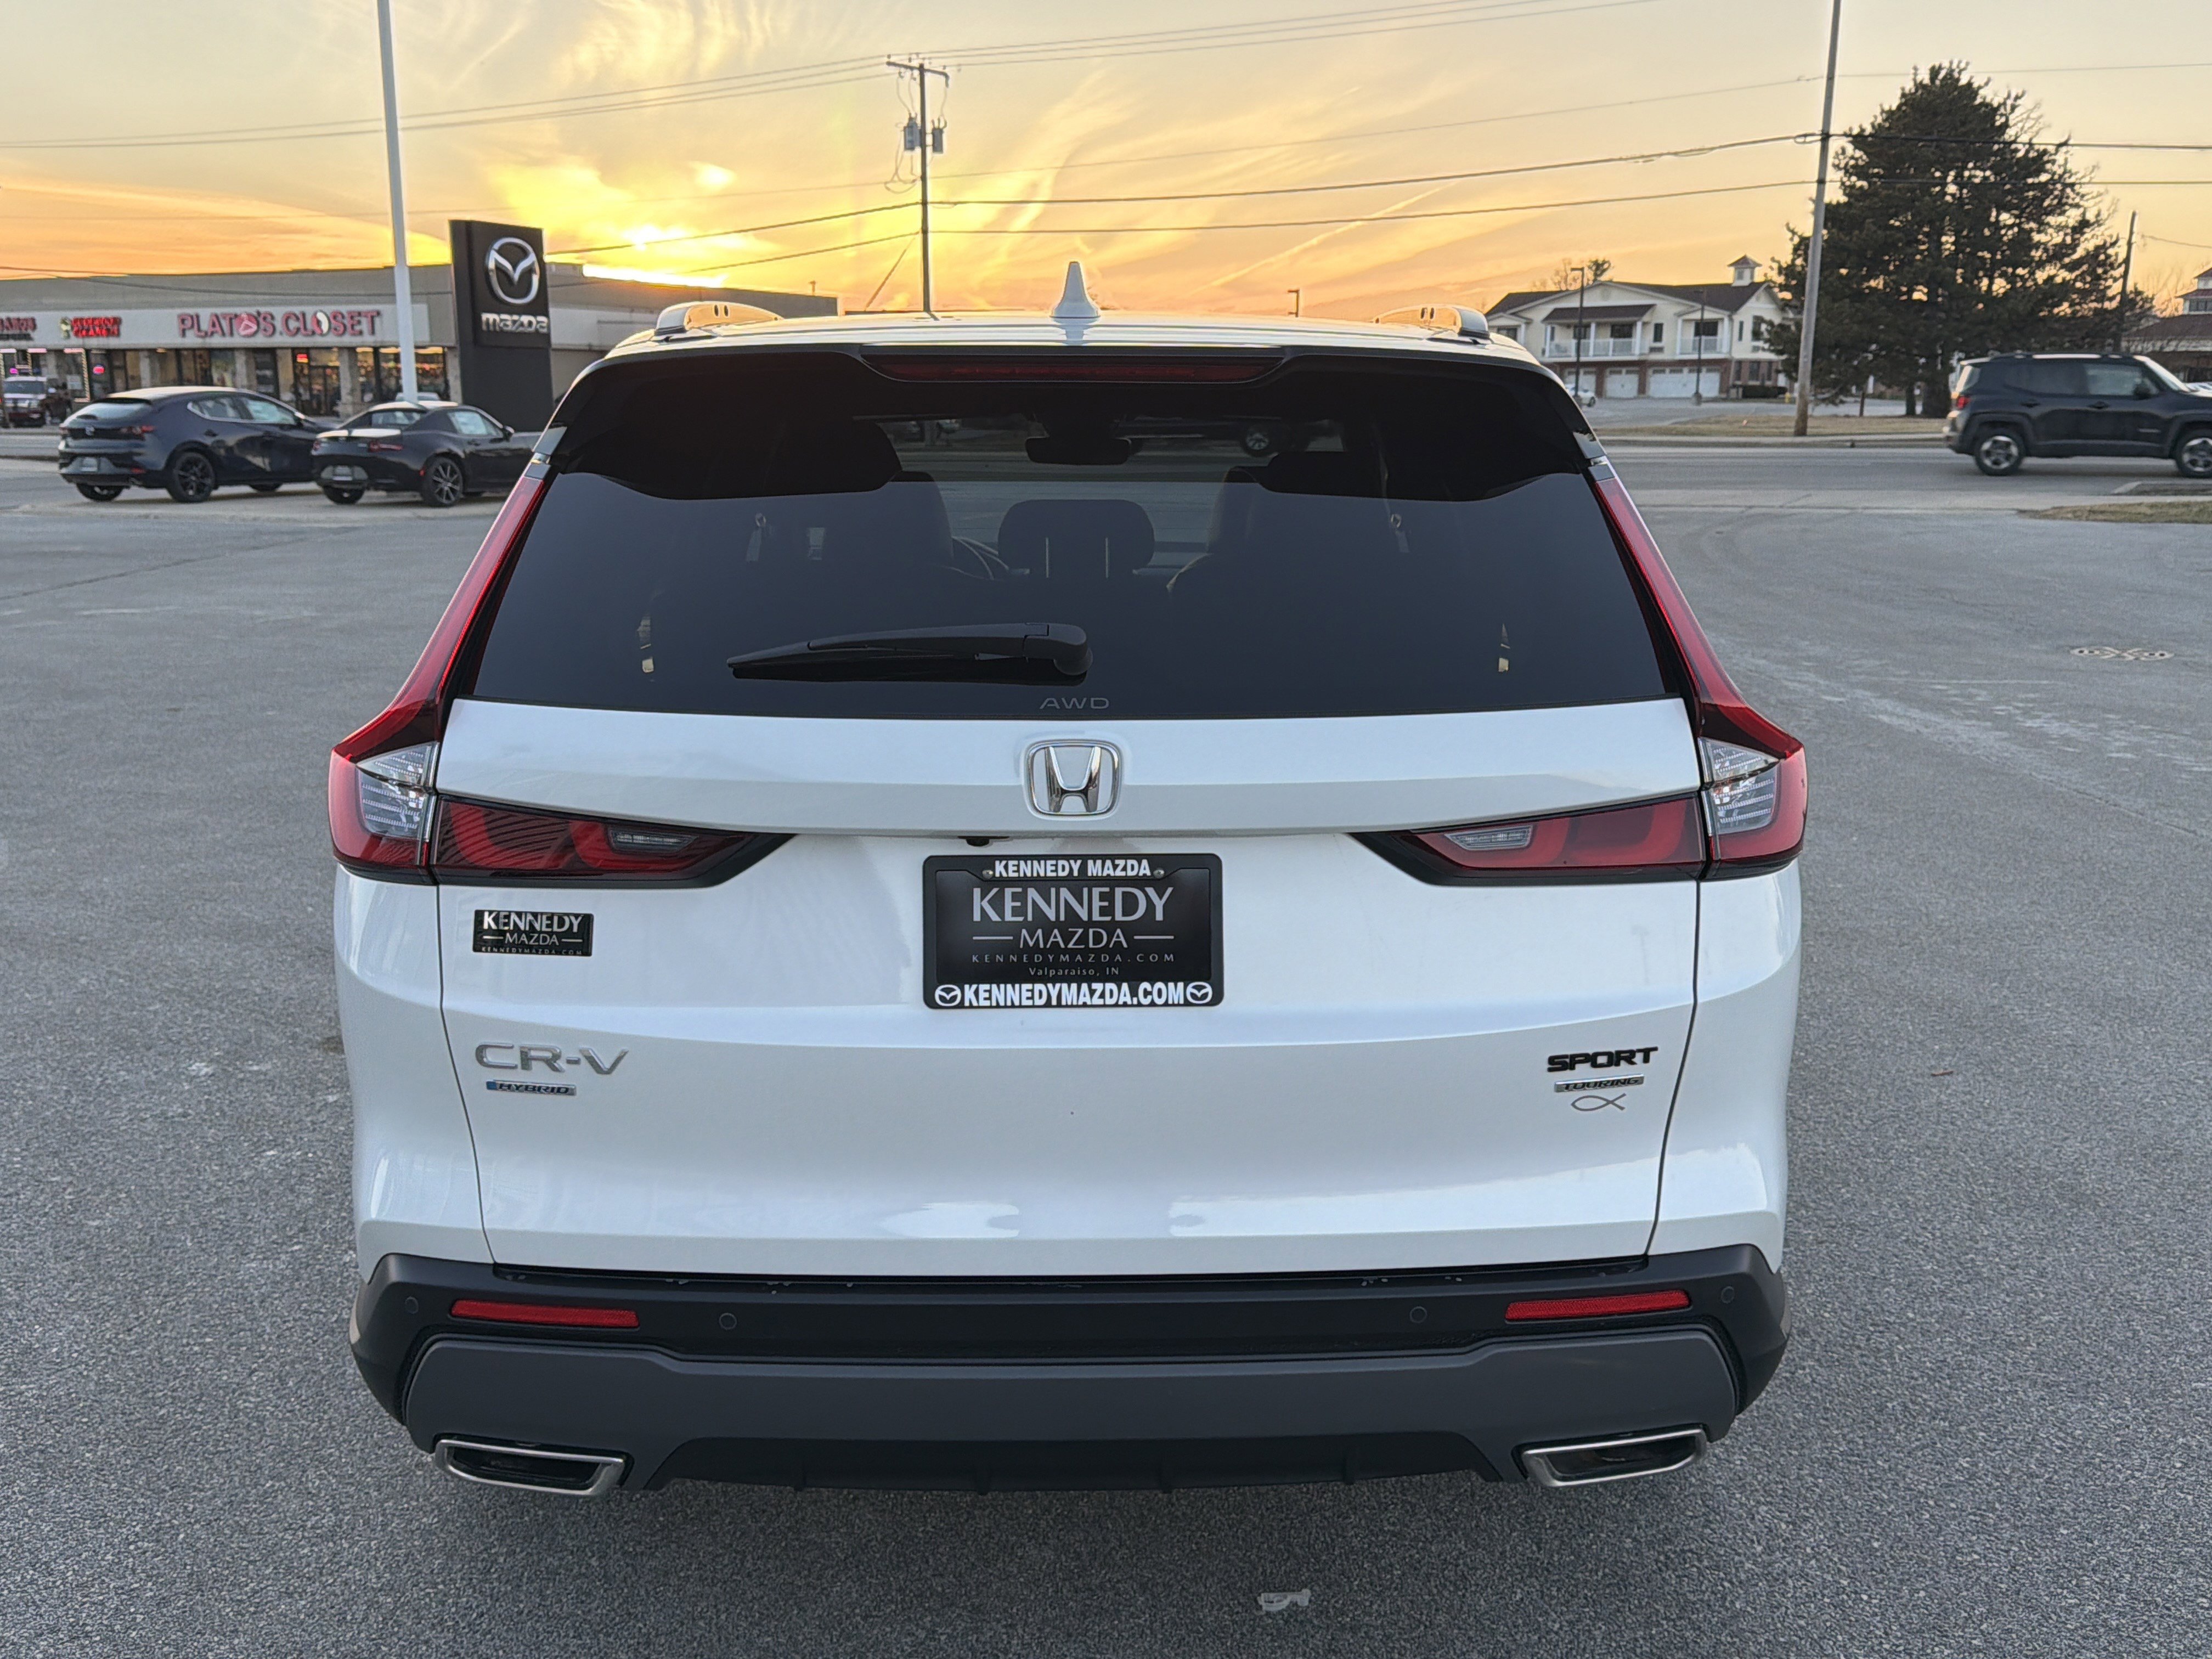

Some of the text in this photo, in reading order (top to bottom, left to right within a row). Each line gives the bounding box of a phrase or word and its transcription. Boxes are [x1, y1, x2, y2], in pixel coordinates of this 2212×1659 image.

[178, 309, 380, 337] PLATO'S CLOSET
[1040, 698, 1109, 709] AWD
[995, 859, 1151, 878] KENNEDY MAZDA
[973, 887, 1174, 922] KENNEDY
[483, 911, 582, 933] KENNEDY
[505, 933, 559, 945] MAZDA
[1019, 928, 1128, 948] MAZDA
[482, 947, 582, 955] KENNEDYMAZDA.COM
[972, 953, 1175, 962] KENNEDYMAZDA.COM
[1029, 967, 1099, 977] Valparaiso,
[964, 982, 1184, 1006] KENNEDYMAZDA.COM
[475, 1043, 629, 1075] CR-V
[1547, 1046, 1658, 1073] SPORT
[499, 1084, 569, 1094] HYBRID
[1564, 1077, 1639, 1090] TOURING
